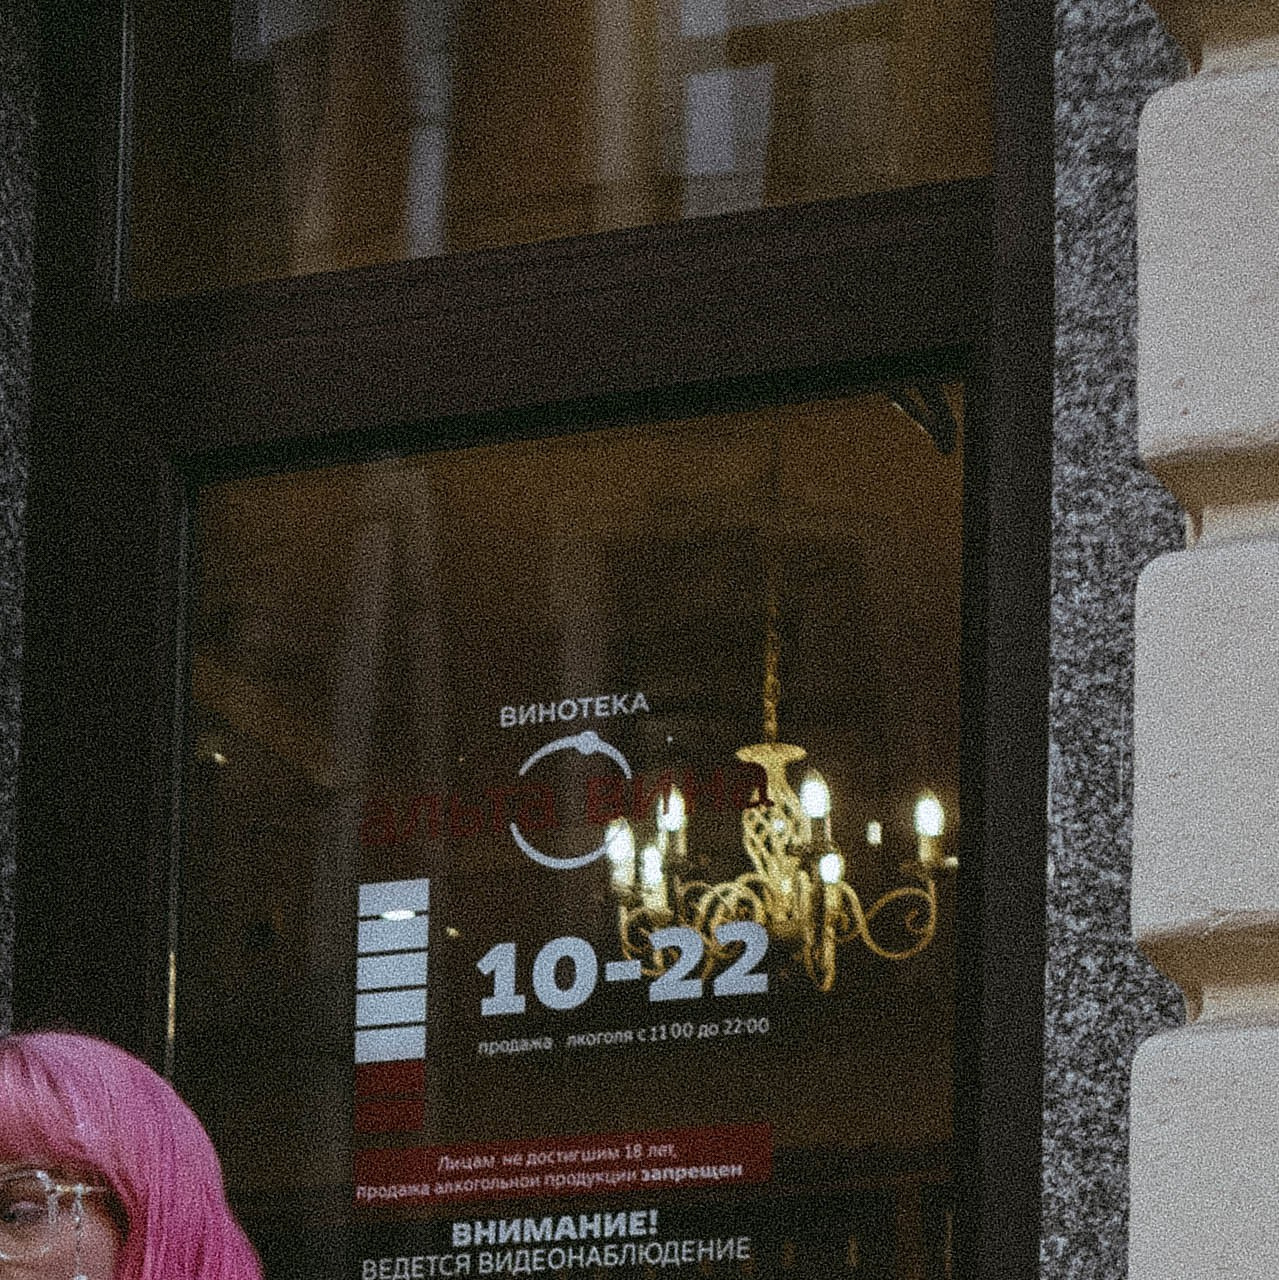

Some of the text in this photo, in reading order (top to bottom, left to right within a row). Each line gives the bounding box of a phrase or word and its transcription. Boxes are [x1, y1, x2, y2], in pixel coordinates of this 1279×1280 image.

[500, 692, 650, 728] ВИНОТЕКА
[476, 920, 769, 1016] 10-22
[477, 1037, 552, 1056] продажа
[637, 1027, 648, 1043] с
[698, 1024, 719, 1039] до
[437, 1155, 495, 1172] Лицам
[502, 1153, 522, 1166] не
[525, 1146, 620, 1167] достигшим
[624, 1143, 643, 1159] 18
[356, 1182, 430, 1202] продажа
[544, 1171, 637, 1189] продукции
[641, 1163, 743, 1183] запрещен
[451, 1209, 658, 1247] ВНИМАНИЕ!
[478, 1236, 751, 1276] ВИДЕОНАБЛЮДЕНИЕ
